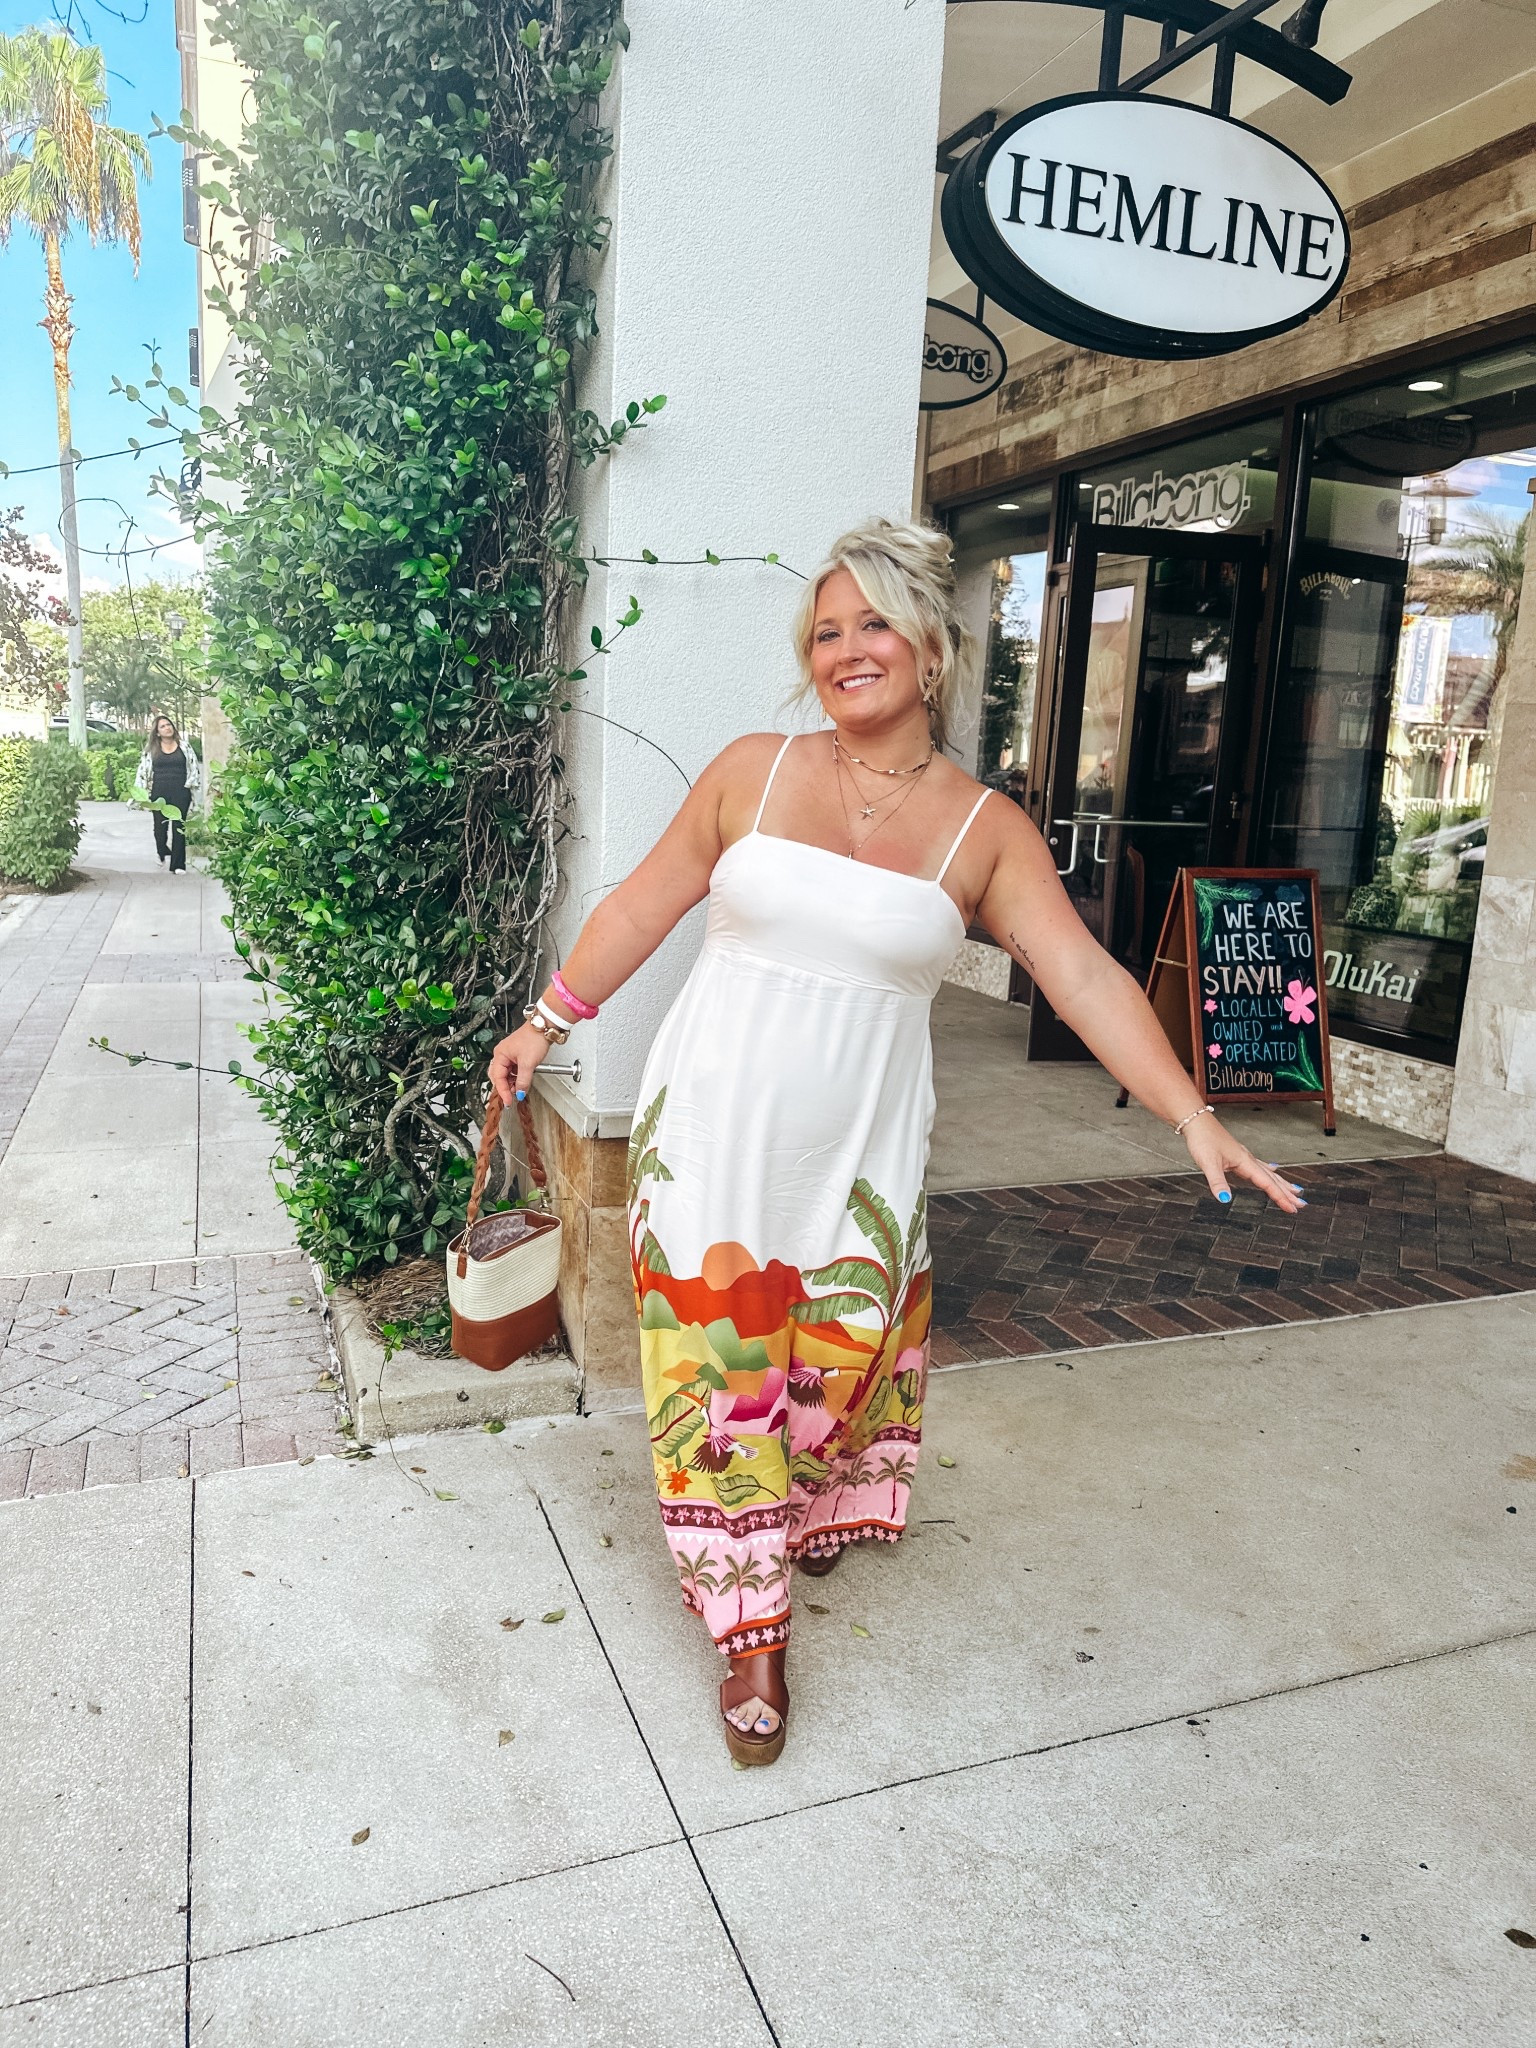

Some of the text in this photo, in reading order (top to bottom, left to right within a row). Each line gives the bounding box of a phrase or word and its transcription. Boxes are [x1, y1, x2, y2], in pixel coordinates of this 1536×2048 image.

[1001, 152, 1335, 282] HEMLINE
[1223, 901, 1308, 929] WE ARE
[1215, 933, 1311, 962] HERE TO
[1203, 965, 1283, 995] STAY!!
[1323, 950, 1420, 1003] OluKai
[1220, 999, 1285, 1018] LOCALLY
[1213, 1020, 1283, 1041] OWNED and
[1225, 1042, 1297, 1063] OPERATED
[1208, 1061, 1273, 1092] Billabong
